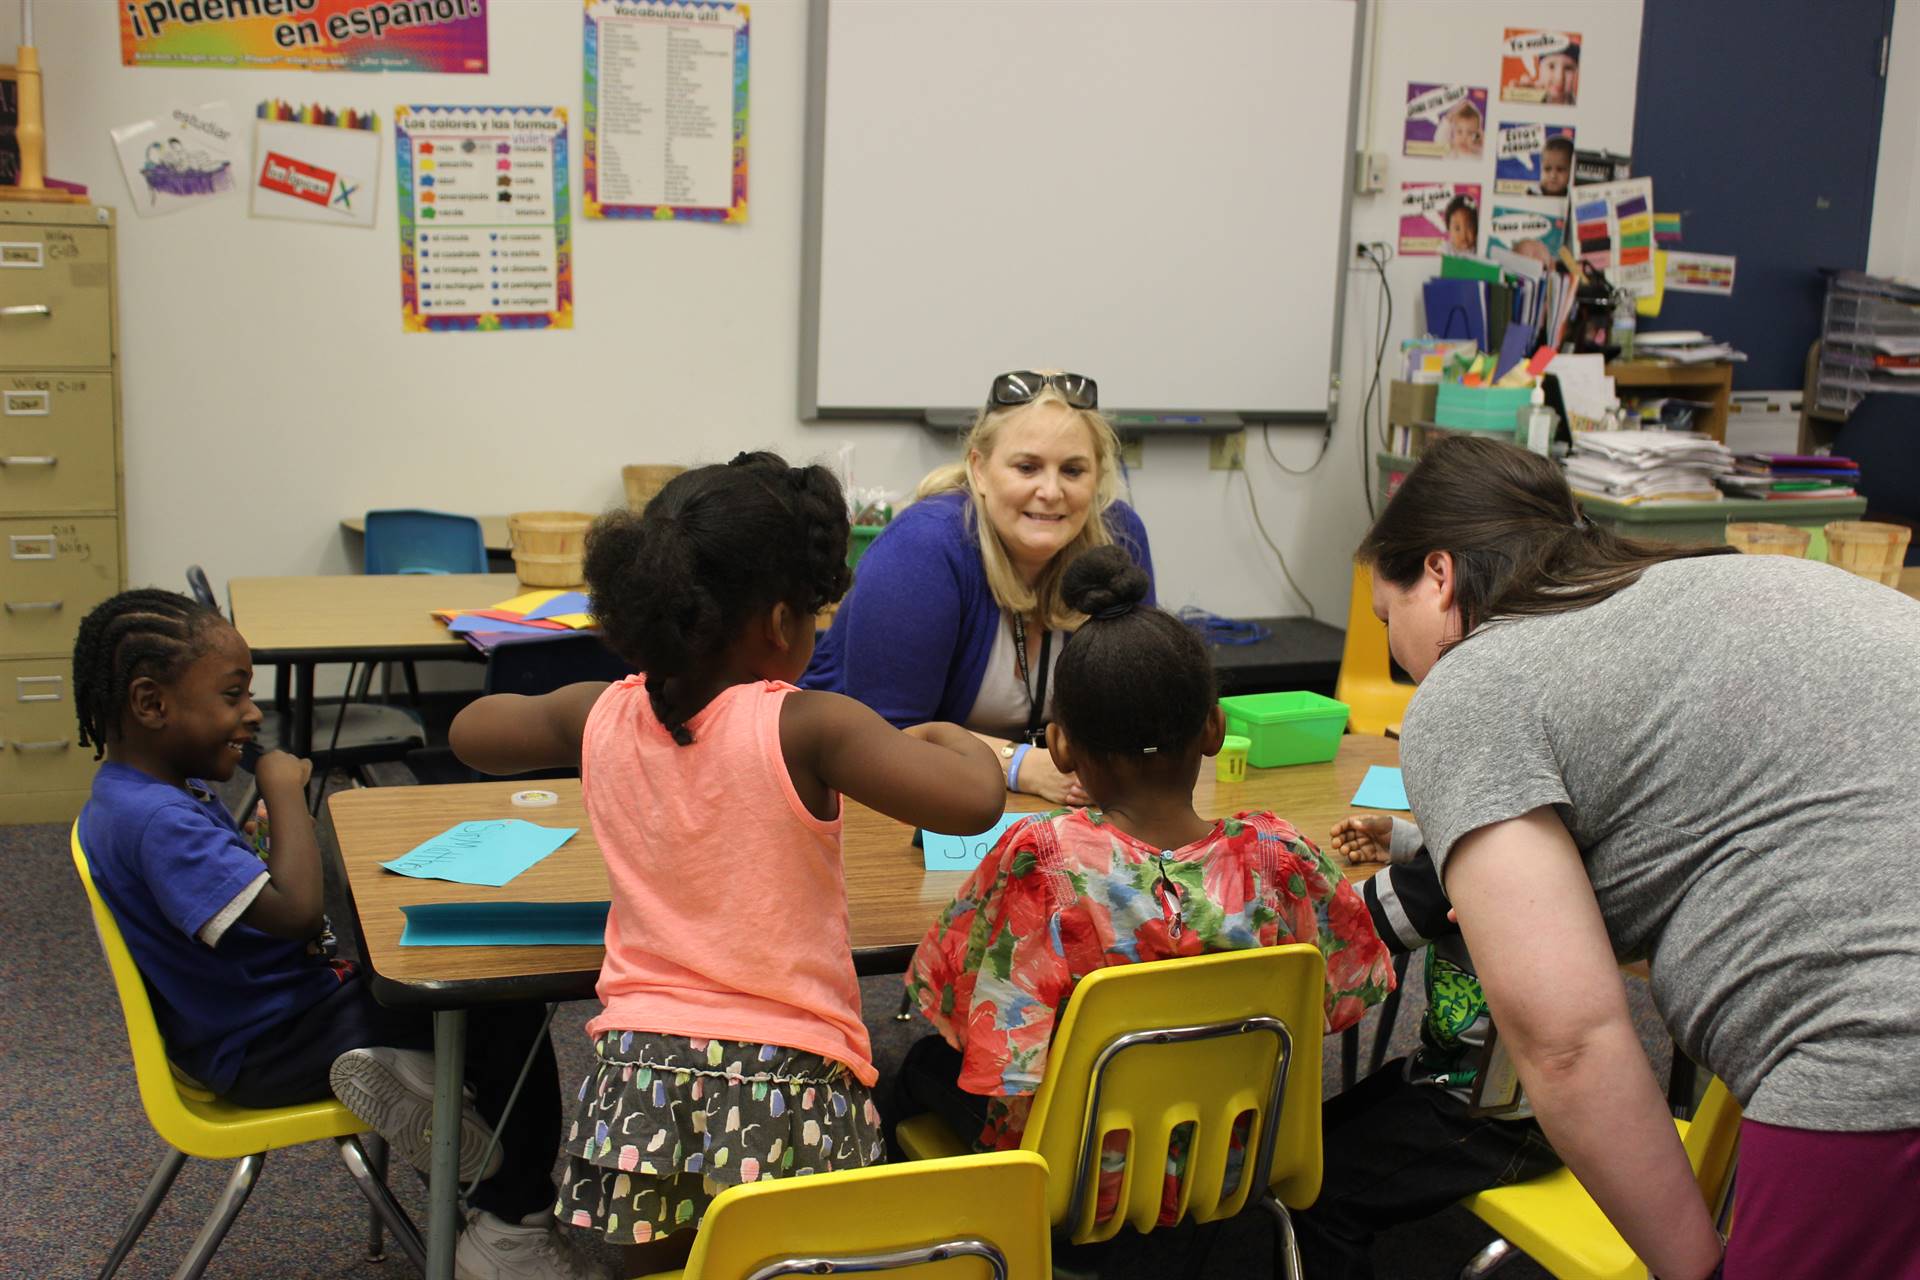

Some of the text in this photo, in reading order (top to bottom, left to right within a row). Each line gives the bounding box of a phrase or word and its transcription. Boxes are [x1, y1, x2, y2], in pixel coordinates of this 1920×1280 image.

[276, 21, 319, 47] en
[404, 119, 558, 130] Los colores y las formas
